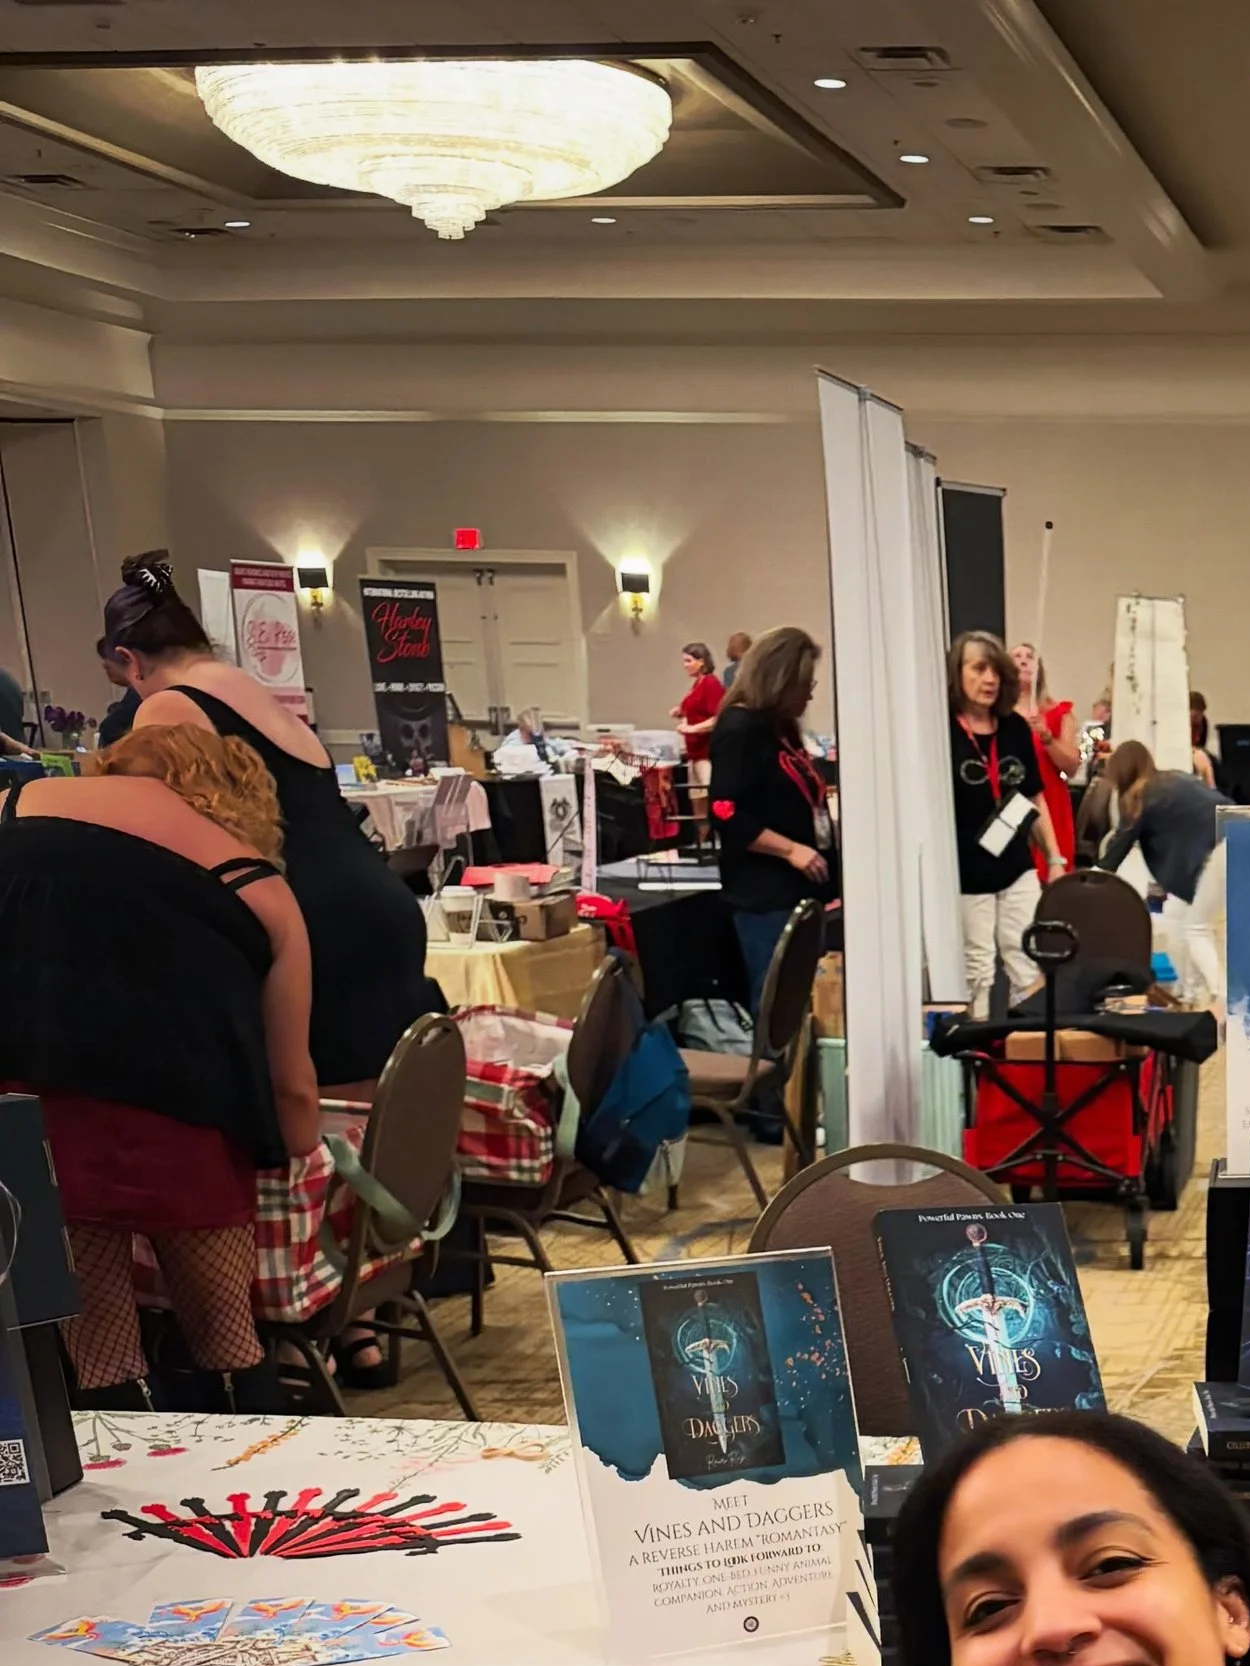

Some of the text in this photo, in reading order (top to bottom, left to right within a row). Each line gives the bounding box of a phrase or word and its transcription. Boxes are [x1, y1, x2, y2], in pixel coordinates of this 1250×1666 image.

[918, 1212, 955, 1223] Powerful
[985, 1211, 1007, 1220] Book
[1008, 1211, 1026, 1220] One
[683, 1414, 761, 1443] DAGGERS
[712, 1494, 748, 1511] MEET
[634, 1501, 834, 1545] VINES AND DAGGERS
[629, 1520, 848, 1567] A REVERSE HAREM "ROMANTASY"
[657, 1562, 703, 1577] THINGS
[706, 1559, 721, 1569] TO
[723, 1555, 749, 1569] LOOK
[750, 1546, 803, 1564] FORWARD
[706, 1601, 732, 1614] AND
[732, 1594, 777, 1610] MYSTERY
